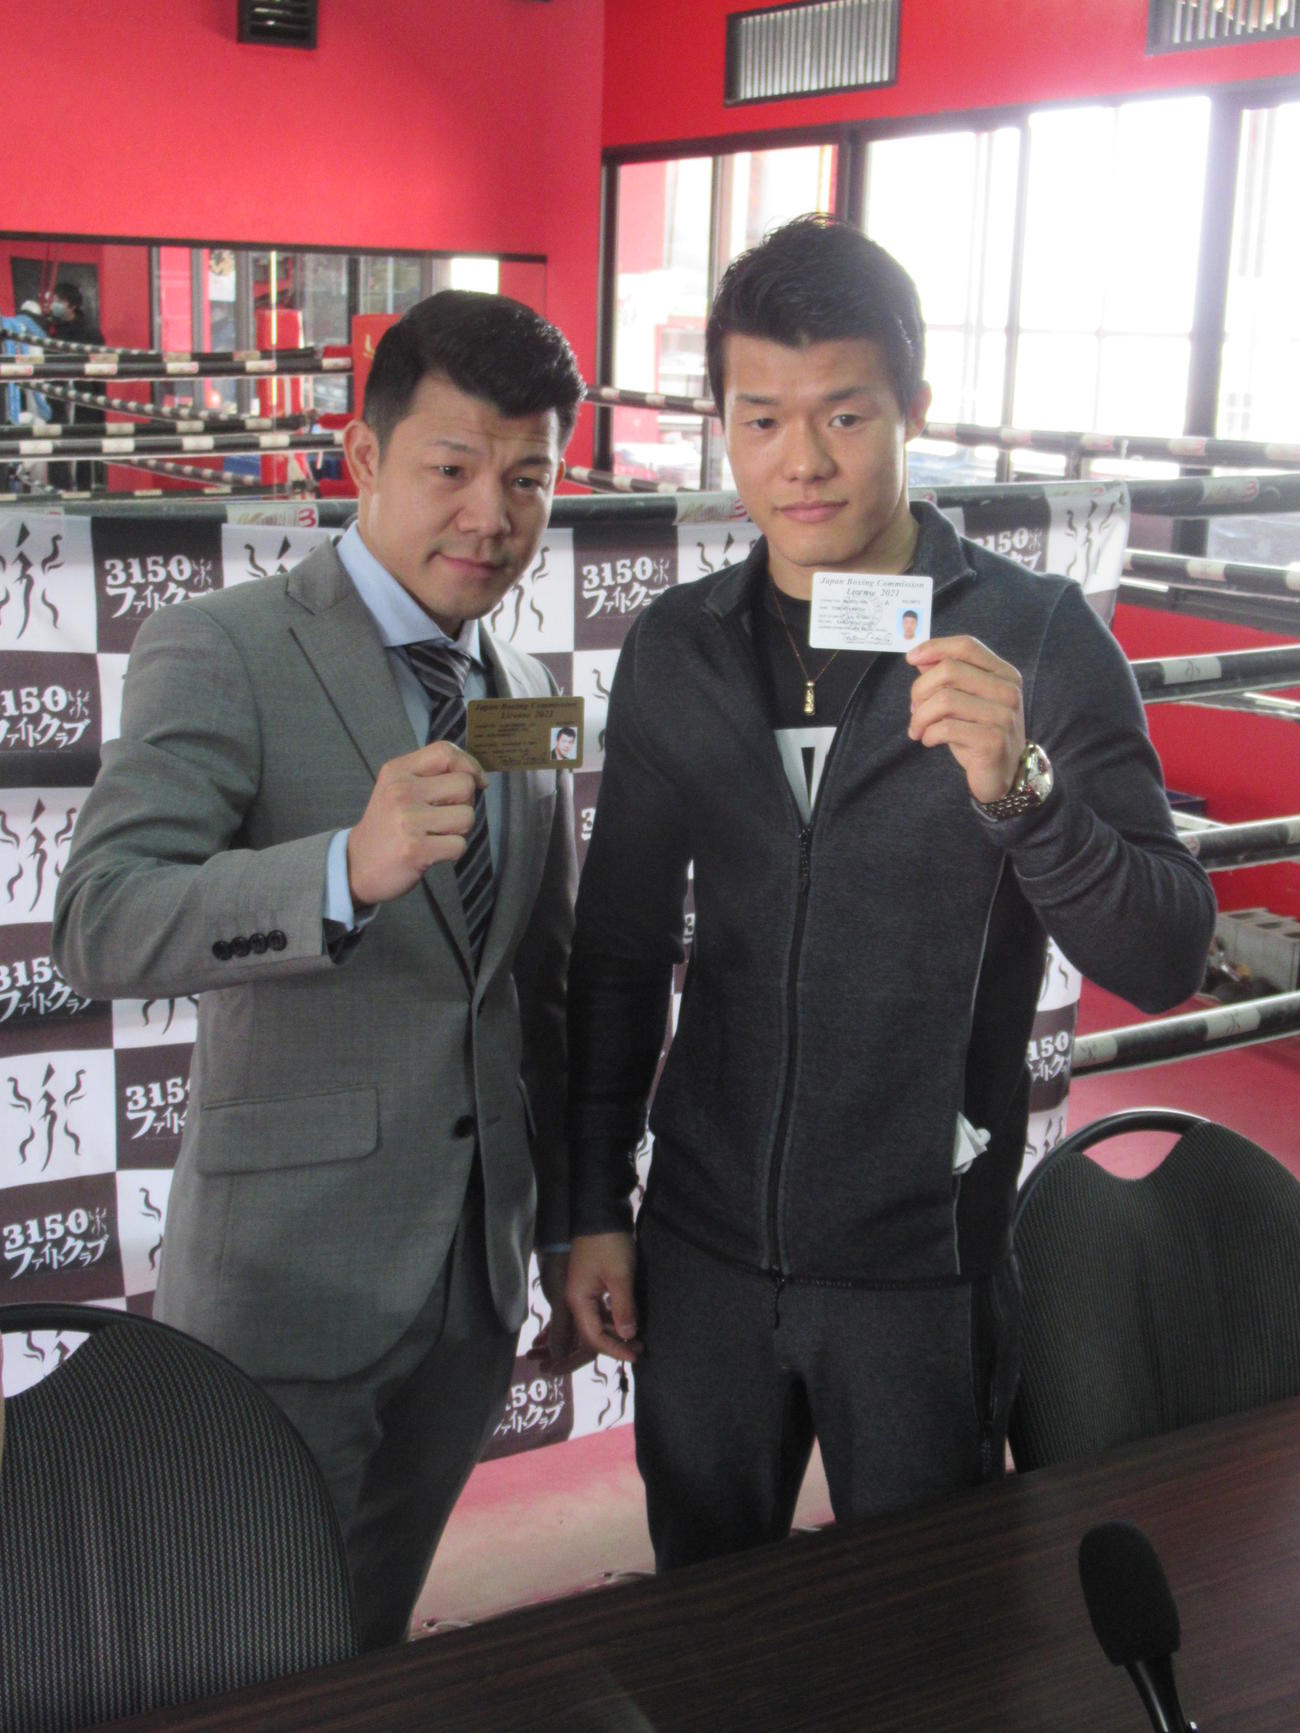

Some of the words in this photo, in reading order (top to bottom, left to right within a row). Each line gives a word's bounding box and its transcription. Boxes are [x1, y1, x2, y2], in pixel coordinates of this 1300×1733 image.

[104, 555, 193, 586] 3150
[582, 556, 653, 589] 3150
[820, 577, 844, 586] Japan
[847, 577, 875, 587] Boxing
[875, 579, 925, 588] Commission
[0, 685, 68, 717] 150
[0, 955, 64, 991] 315
[1026, 1030, 1069, 1062] 150
[126, 1077, 190, 1111] 315
[3, 1208, 89, 1250] 3150
[4, 1234, 110, 1280] ファイトクラブ
